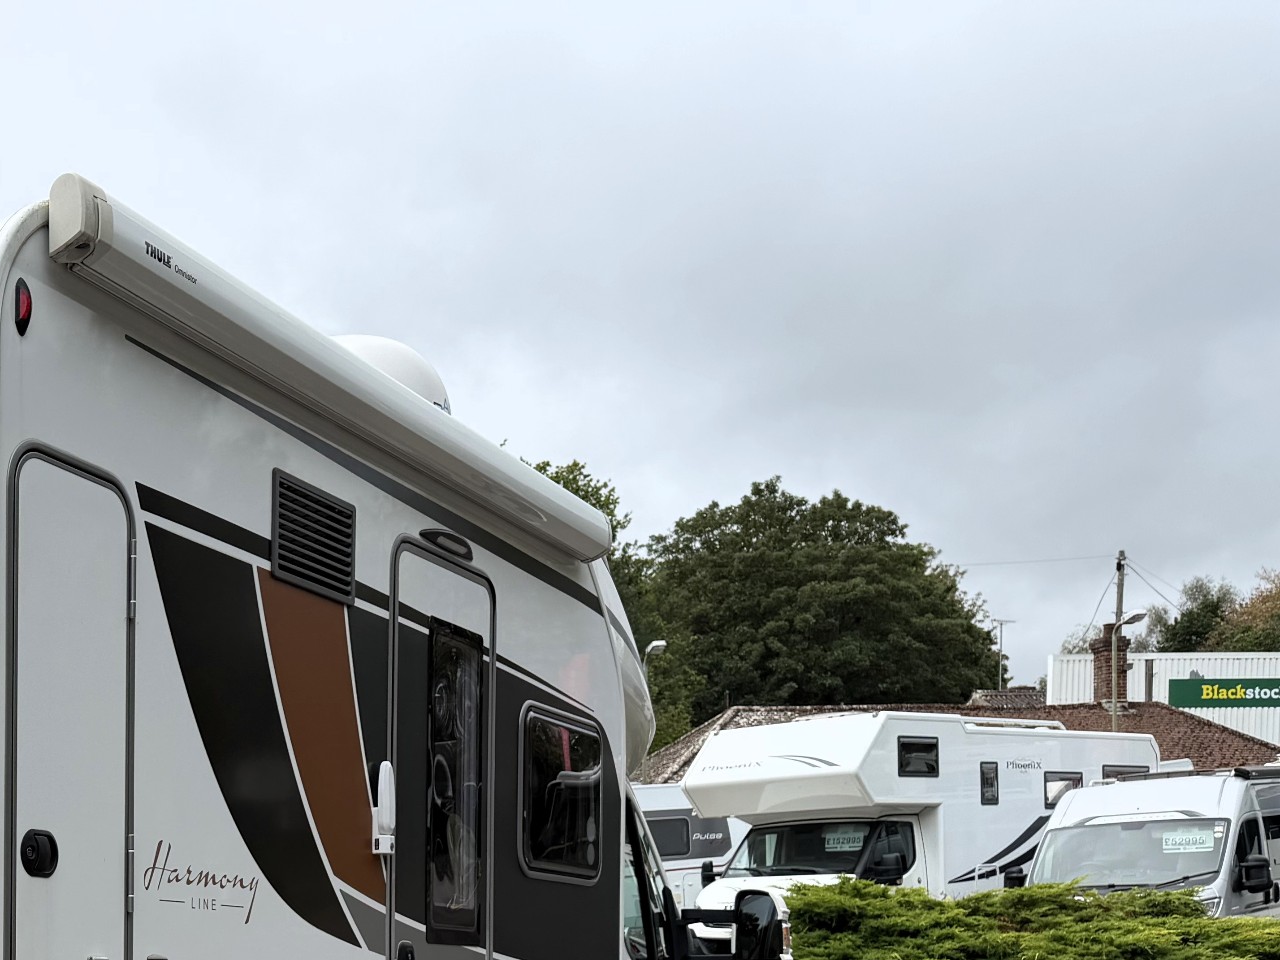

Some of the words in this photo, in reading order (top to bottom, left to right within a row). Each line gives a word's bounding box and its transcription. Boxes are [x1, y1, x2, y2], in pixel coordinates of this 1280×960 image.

[144, 240, 172, 269] THULE
[1201, 684, 1280, 699] Blackstoc
[143, 840, 259, 925] Harmony
[191, 897, 217, 911] LINE
